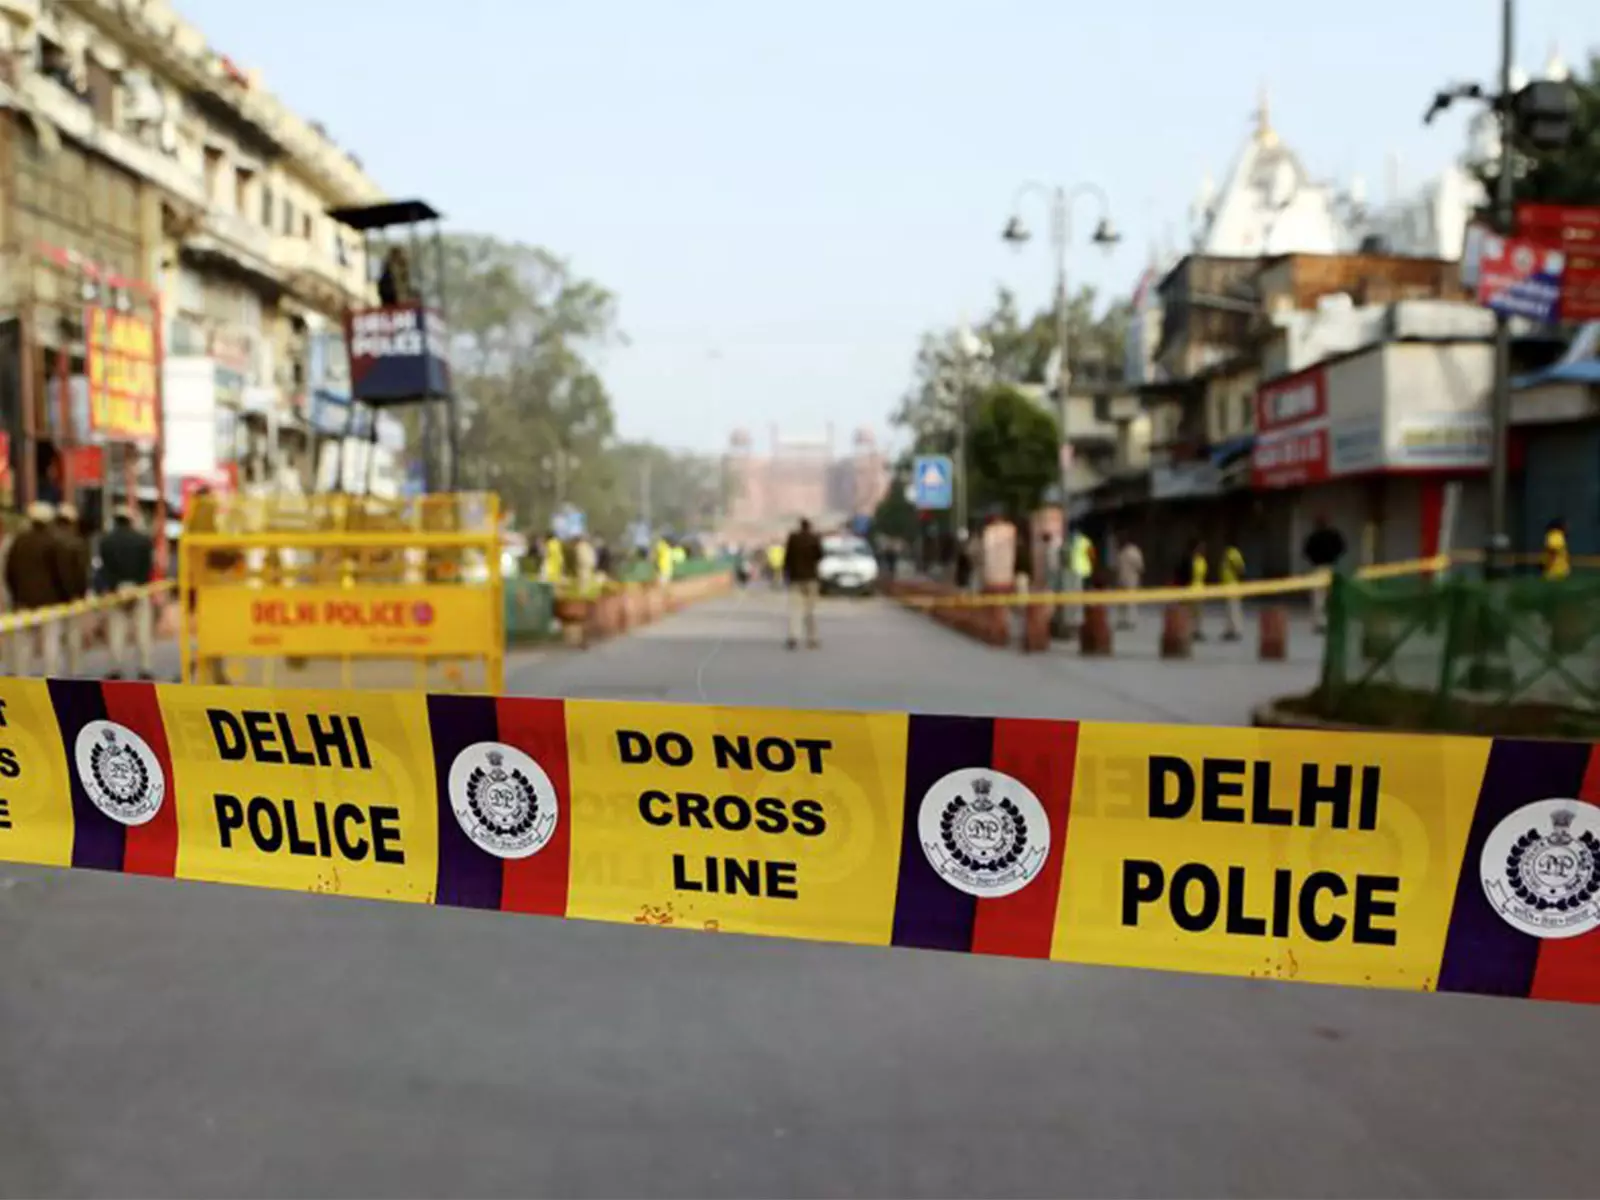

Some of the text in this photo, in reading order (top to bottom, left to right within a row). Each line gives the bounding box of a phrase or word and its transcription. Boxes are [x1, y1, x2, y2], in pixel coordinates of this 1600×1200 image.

[252, 601, 406, 627] DELHI POLICE
[206, 708, 372, 770] DELHI
[615, 729, 832, 775] DO NOT
[638, 790, 826, 837] CROSS
[1148, 755, 1381, 831] DELHI
[213, 793, 405, 865] POLICE
[673, 854, 798, 900] LINE
[1122, 859, 1400, 946] POLICE
